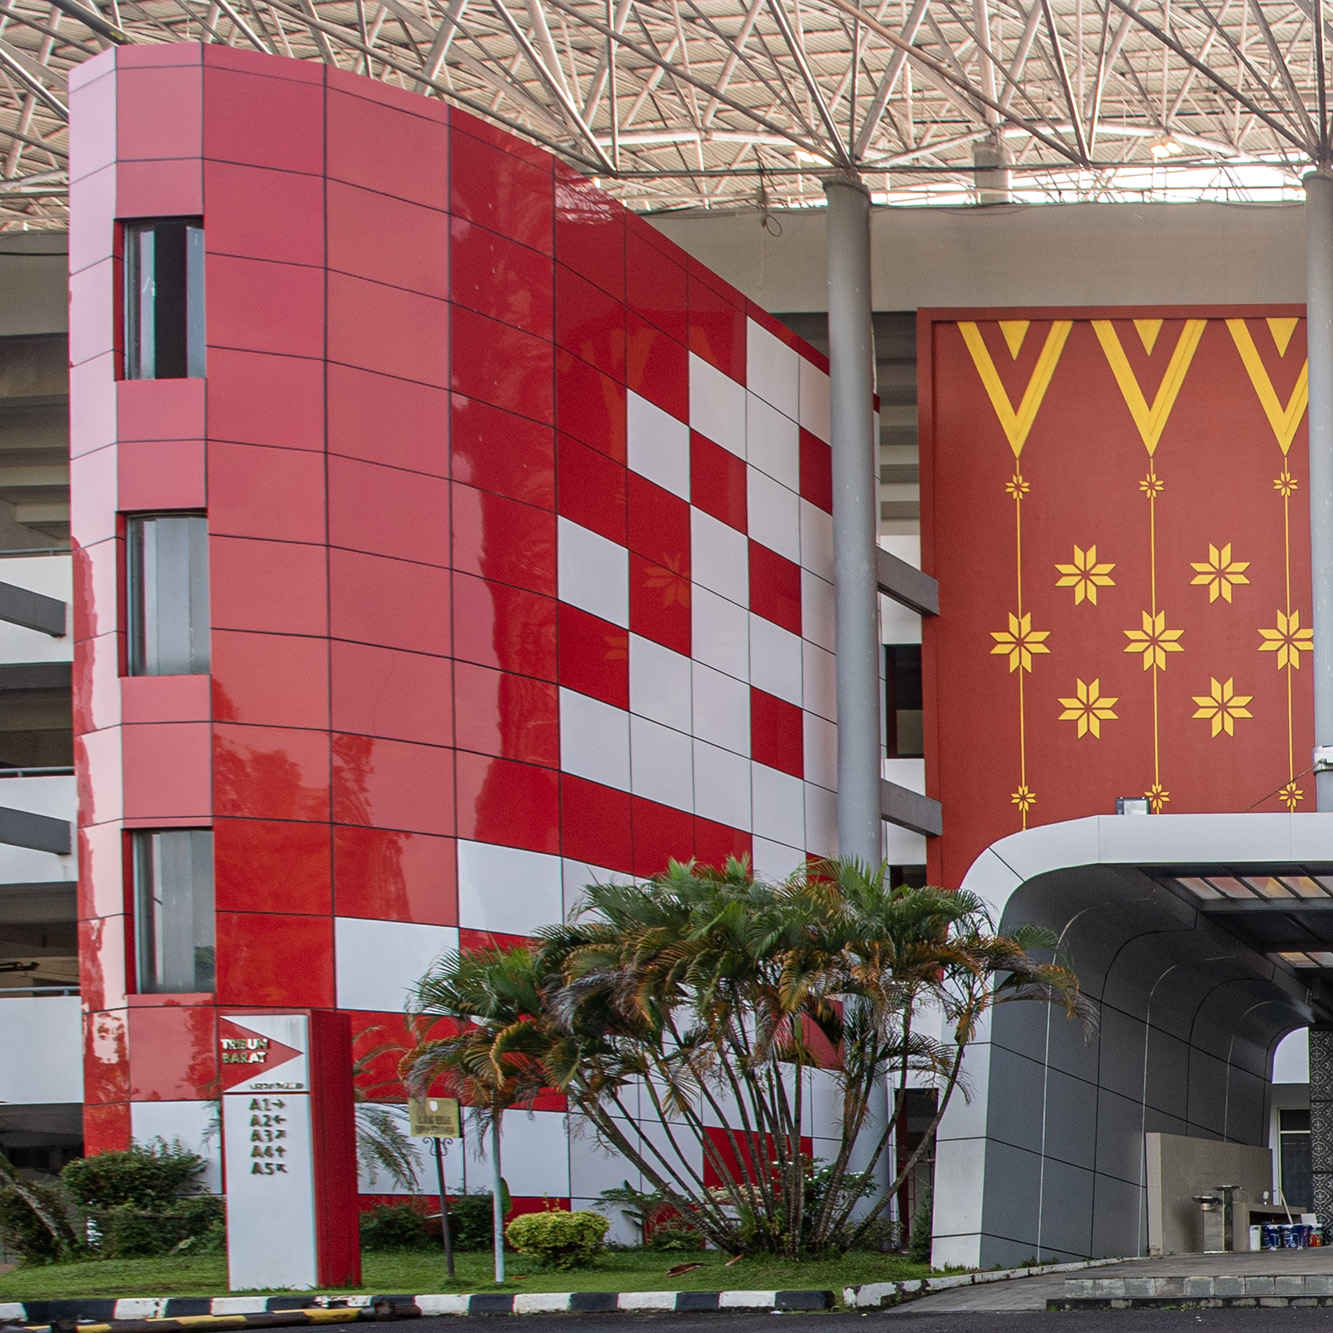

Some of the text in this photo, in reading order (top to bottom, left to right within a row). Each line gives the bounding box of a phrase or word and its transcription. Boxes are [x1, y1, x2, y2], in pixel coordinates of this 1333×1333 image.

[220, 1038, 269, 1050] TRIBUN
[221, 1051, 267, 1064] BARAT
[249, 1098, 272, 1111] A1
[249, 1114, 273, 1127] A2
[250, 1129, 273, 1142] A3
[250, 1145, 274, 1158] A4
[251, 1161, 275, 1175] A5
